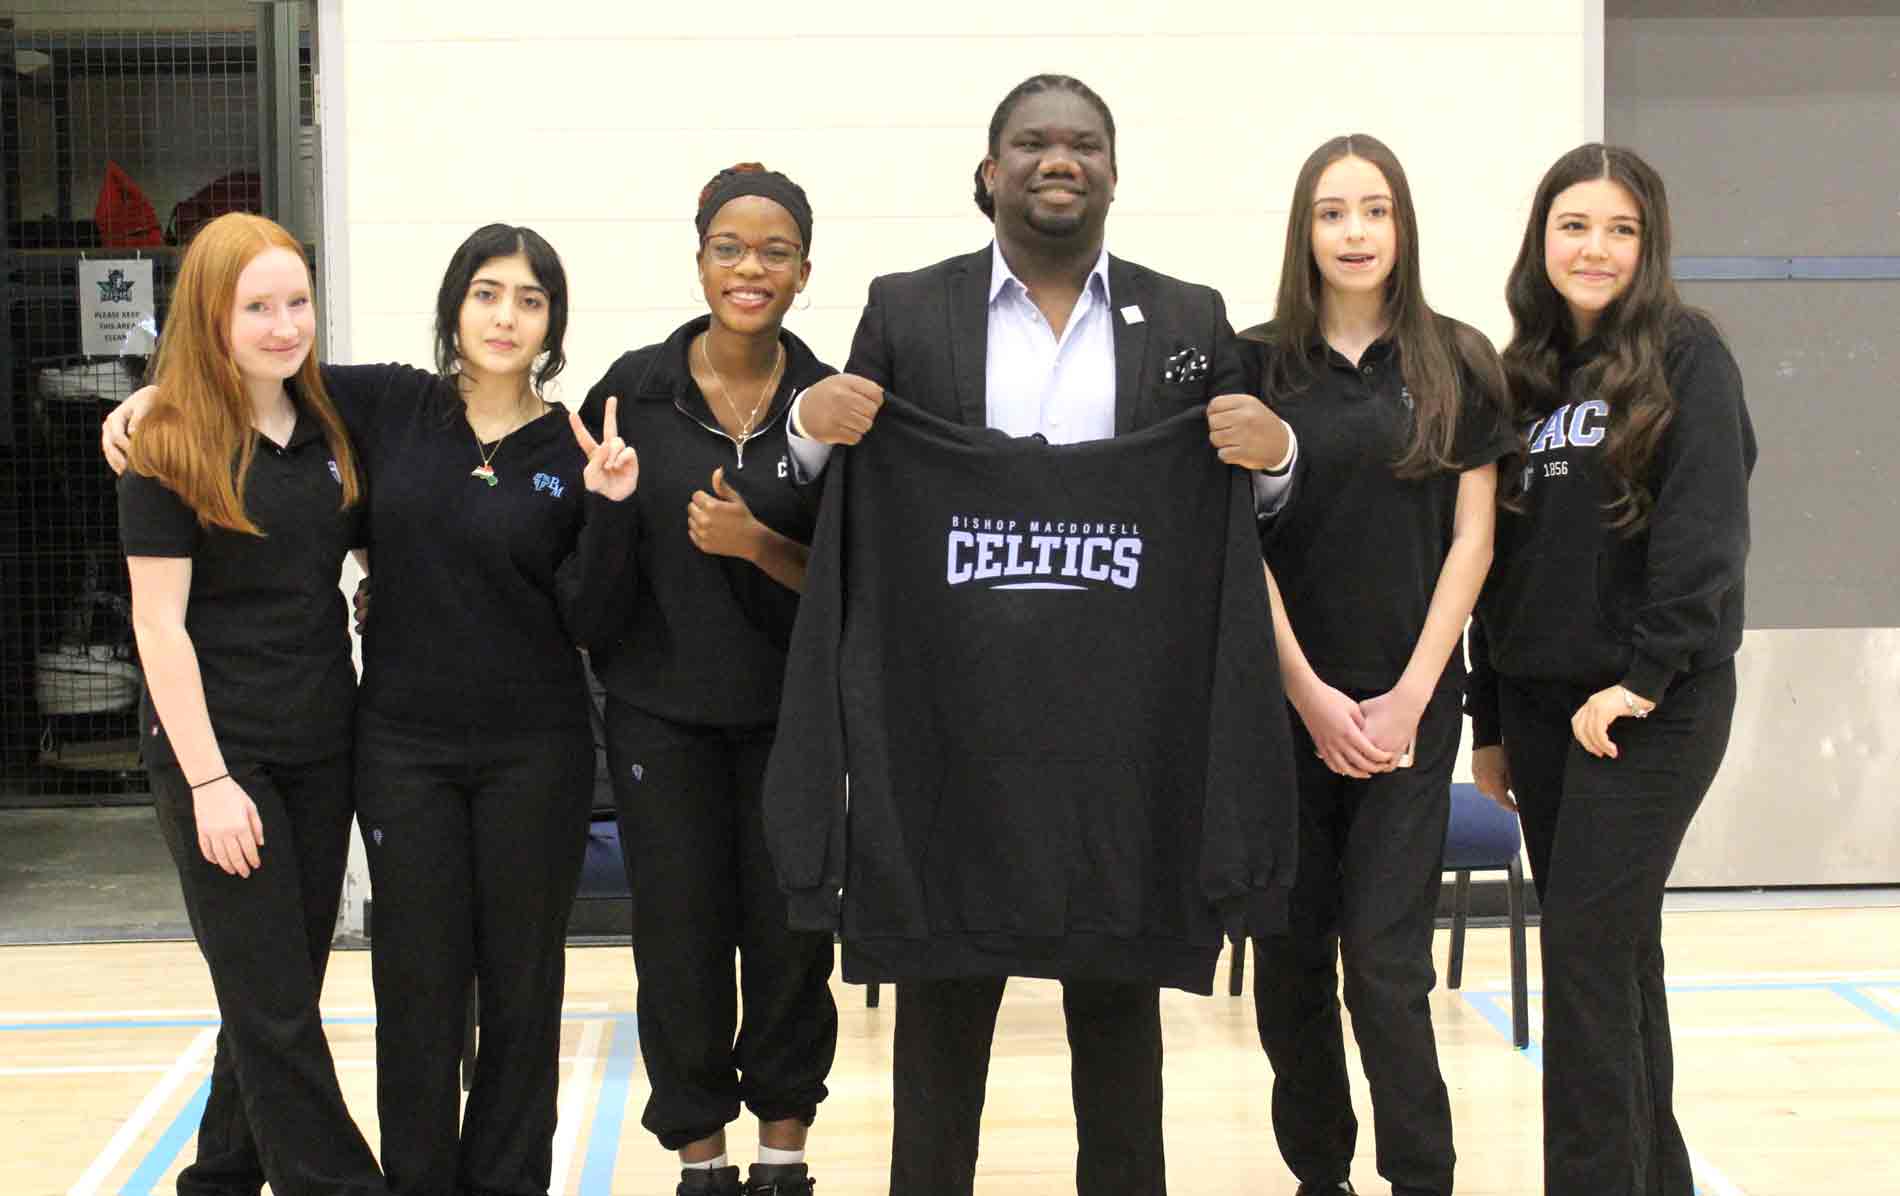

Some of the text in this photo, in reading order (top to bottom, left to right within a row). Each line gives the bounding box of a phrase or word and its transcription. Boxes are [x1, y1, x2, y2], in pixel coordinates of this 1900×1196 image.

[94, 311, 140, 319] PLEASE KEEP
[99, 321, 137, 329] THIS AREA
[1543, 460, 1569, 478] 1856
[952, 516, 1140, 535] BISHOP MACDONELL
[947, 530, 1142, 590] CELTICS
